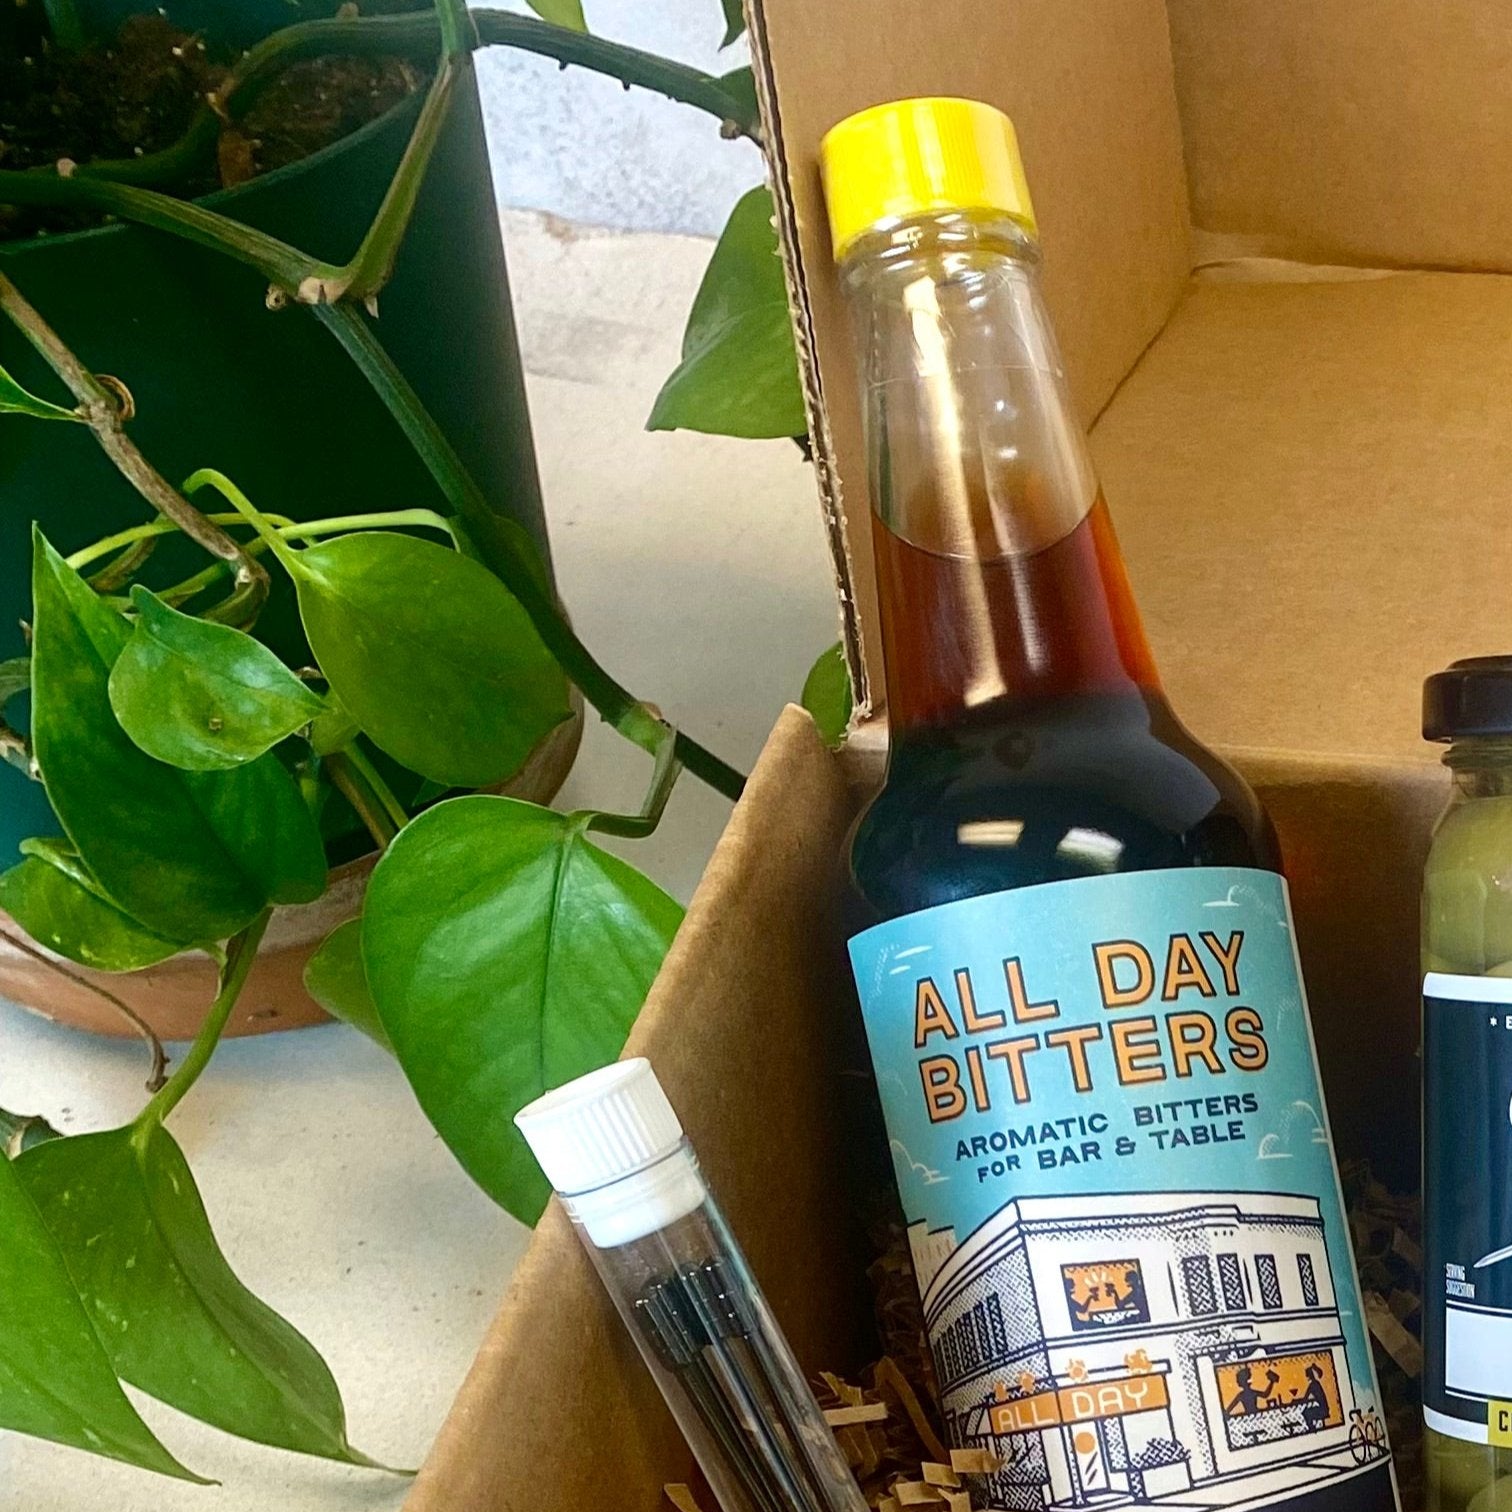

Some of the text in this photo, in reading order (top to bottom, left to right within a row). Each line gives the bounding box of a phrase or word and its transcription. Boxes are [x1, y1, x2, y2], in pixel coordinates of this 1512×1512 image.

[913, 931, 1245, 1048] ALL DAY
[918, 1006, 1270, 1125] BITTERS
[955, 1093, 1259, 1162] AROMATIC BITTERS
[977, 1120, 1247, 1184] FOR BAR & TABLE
[998, 1382, 1149, 1431] ALL DAY
